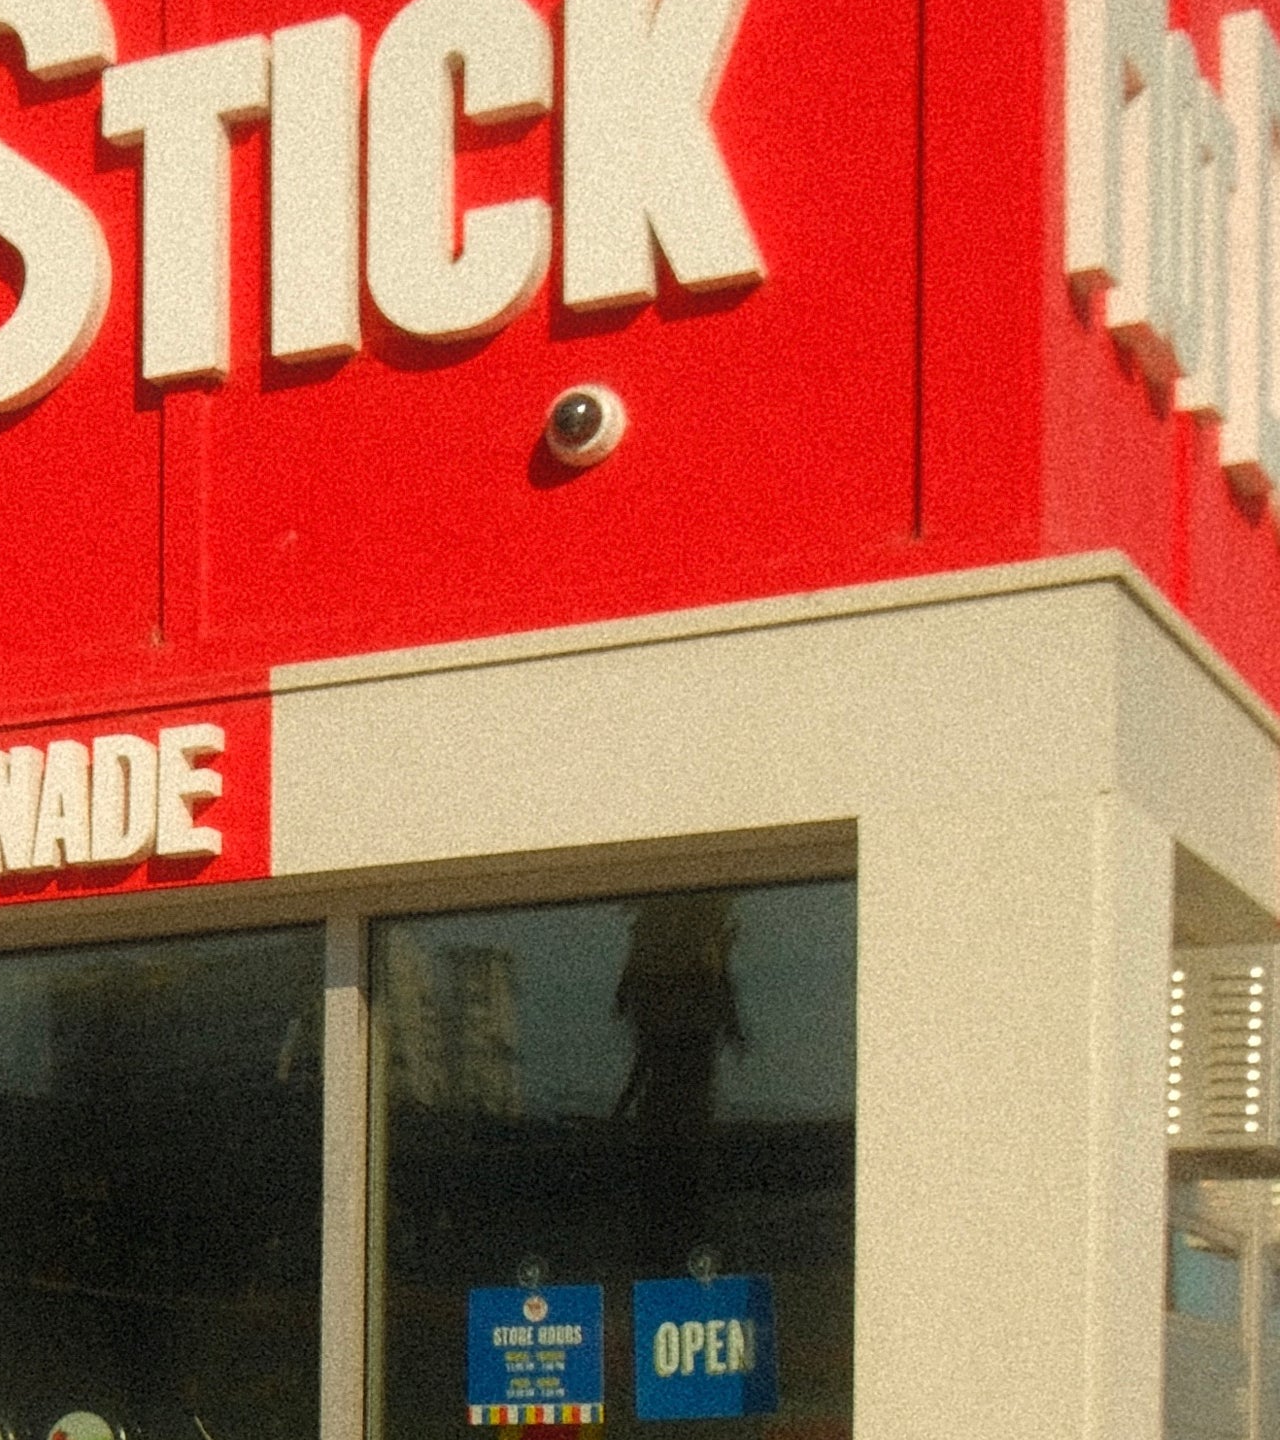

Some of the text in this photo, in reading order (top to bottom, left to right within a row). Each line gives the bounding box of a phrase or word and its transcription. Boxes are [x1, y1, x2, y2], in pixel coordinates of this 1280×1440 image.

[492, 1323, 583, 1347] STORE HOURS
[653, 1318, 756, 1377] OPEN
